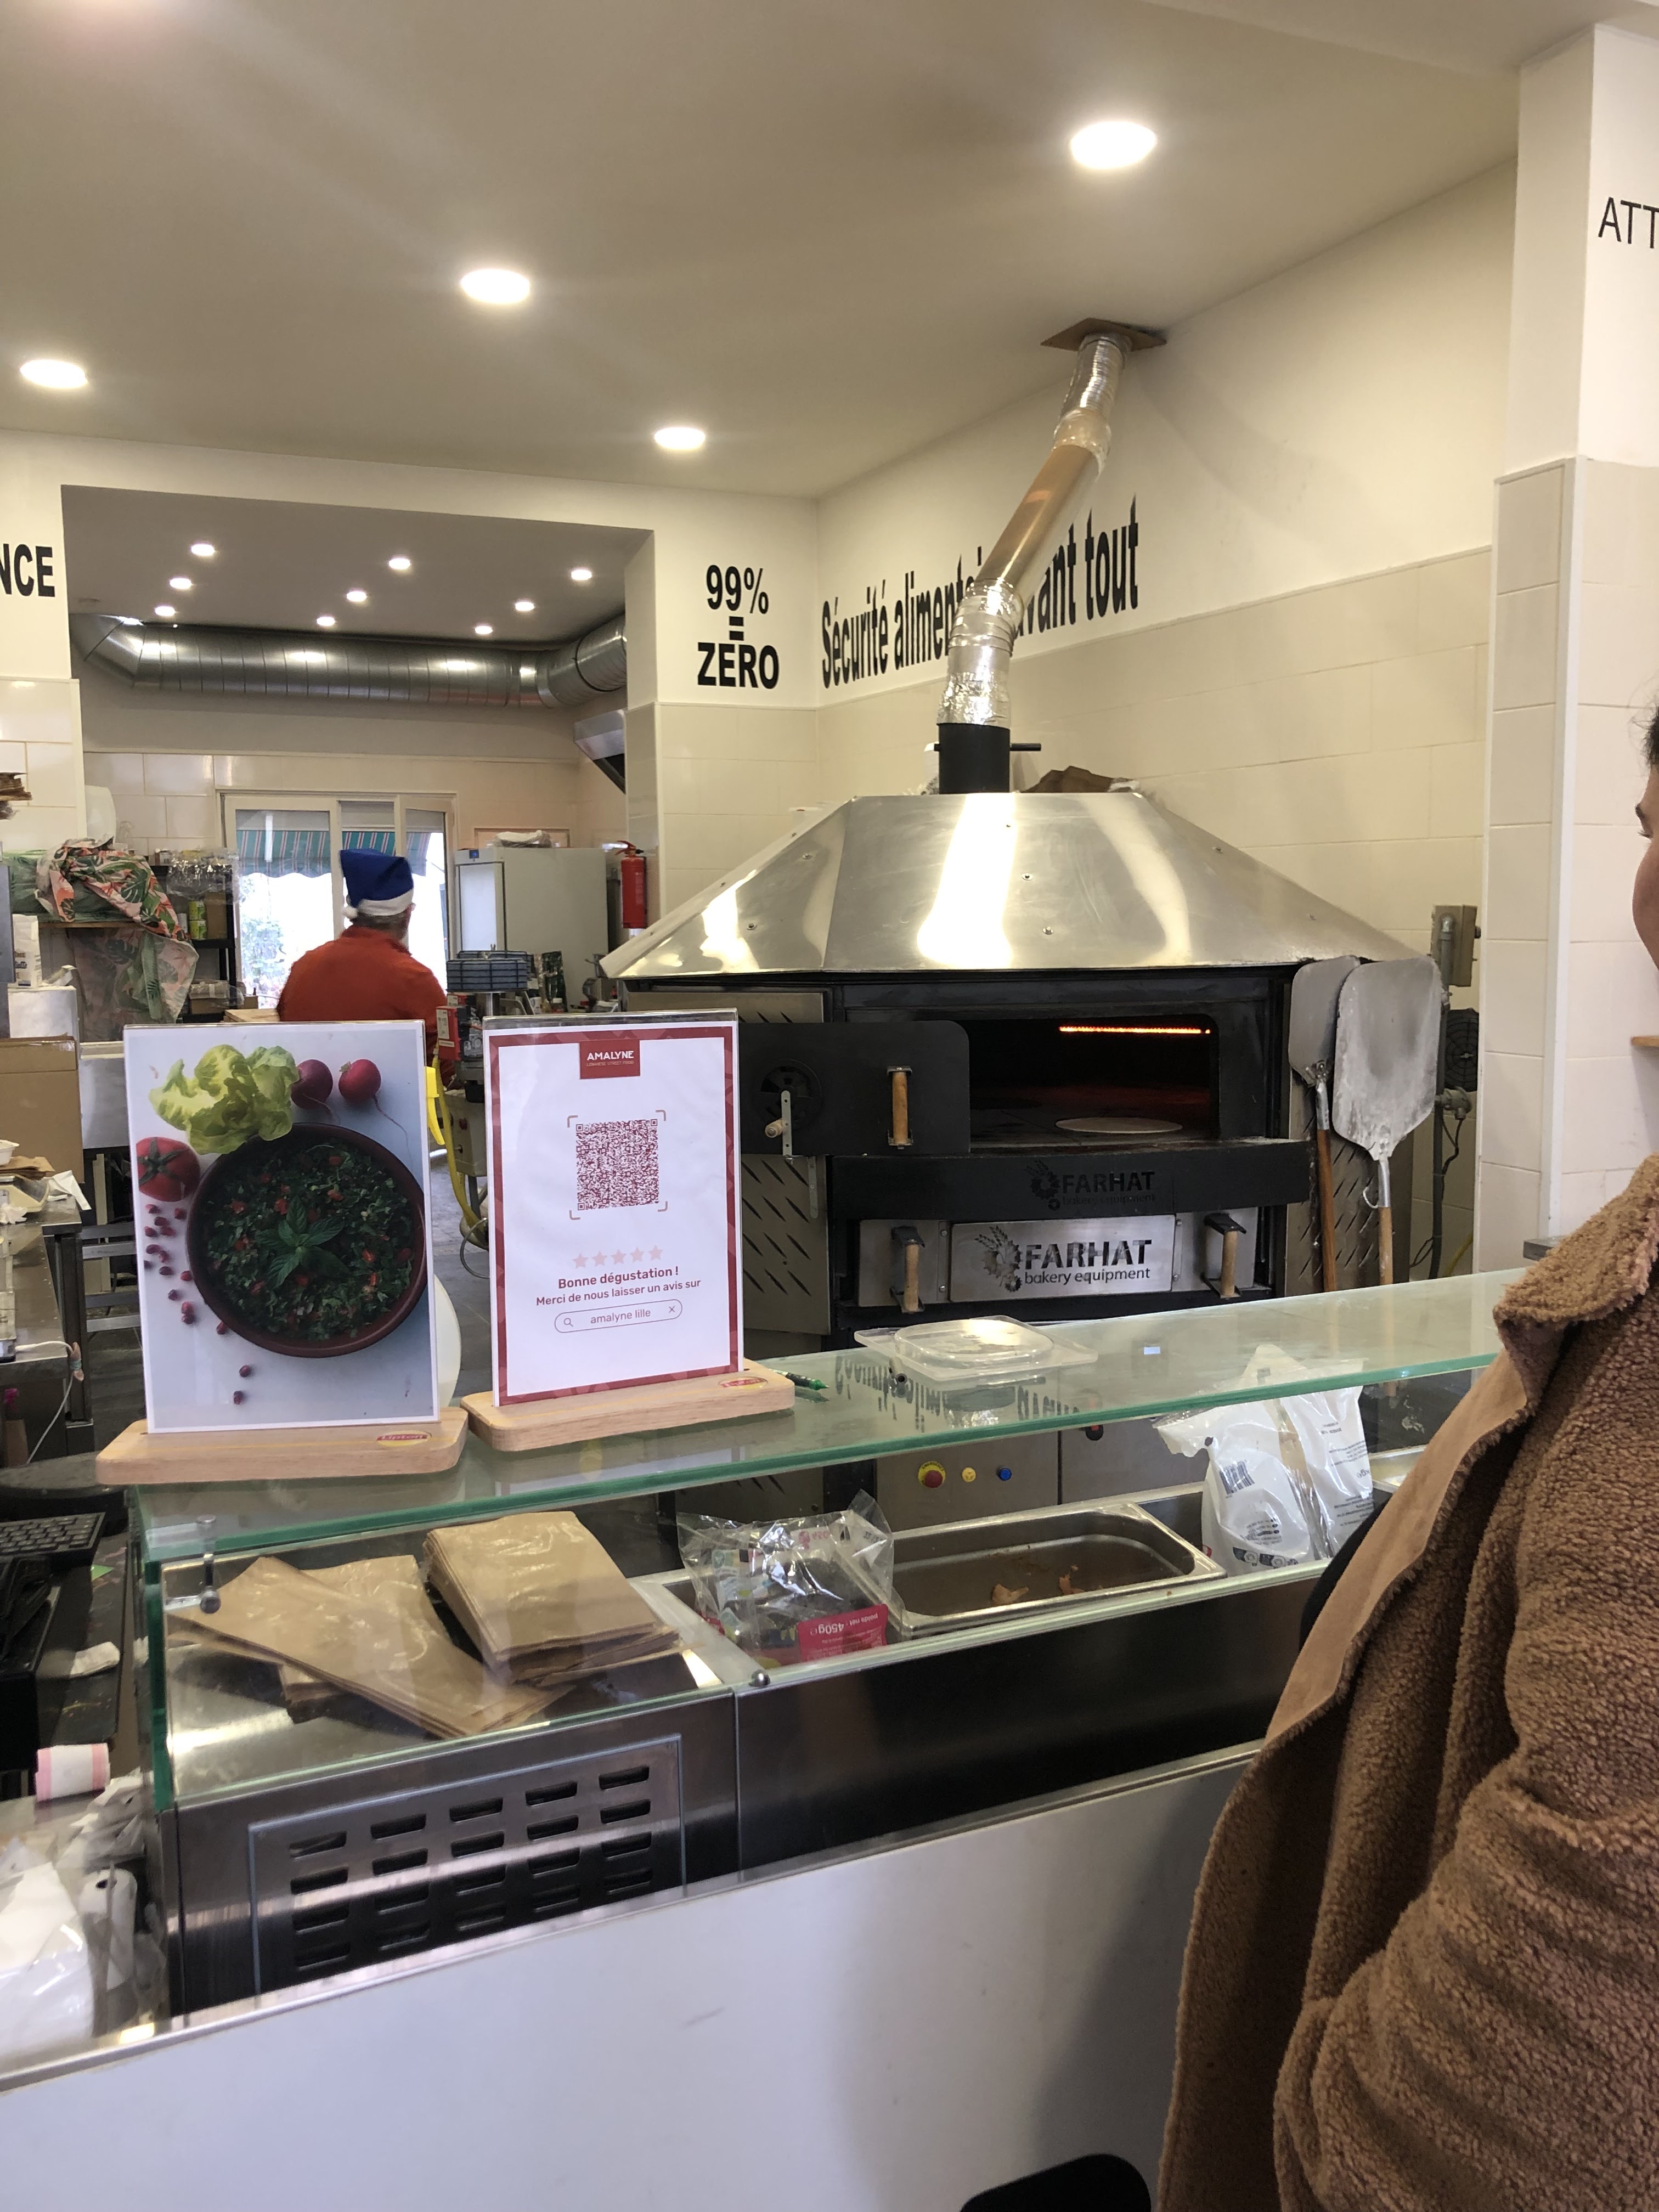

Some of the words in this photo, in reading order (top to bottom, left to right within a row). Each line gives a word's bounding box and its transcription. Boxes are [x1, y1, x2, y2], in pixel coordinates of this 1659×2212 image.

[1598, 196, 1659, 249] ATT
[706, 565, 769, 614] 99%
[822, 579, 888, 689] Sécurité
[894, 546, 982, 670] aliment
[1085, 492, 1138, 618] tout
[697, 642, 780, 690] ZERO
[586, 1050, 634, 1060] AMALYNE
[1063, 1171, 1155, 1194] FARHAT
[1025, 1239, 1152, 1270] FARHAT
[558, 1277, 597, 1289] Bonne
[600, 1267, 673, 1284] dégustation
[1025, 1271, 1071, 1285] bakery
[1074, 1268, 1151, 1284] equipment
[536, 1294, 566, 1306] Merci
[568, 1293, 582, 1302] de
[584, 1290, 609, 1300] nous
[612, 1286, 645, 1297] laisser
[663, 1280, 683, 1291] avis
[685, 1280, 701, 1288] sur
[590, 1312, 632, 1324] amalyne
[635, 1308, 651, 1318] lille
[861, 1612, 878, 1622] poids
